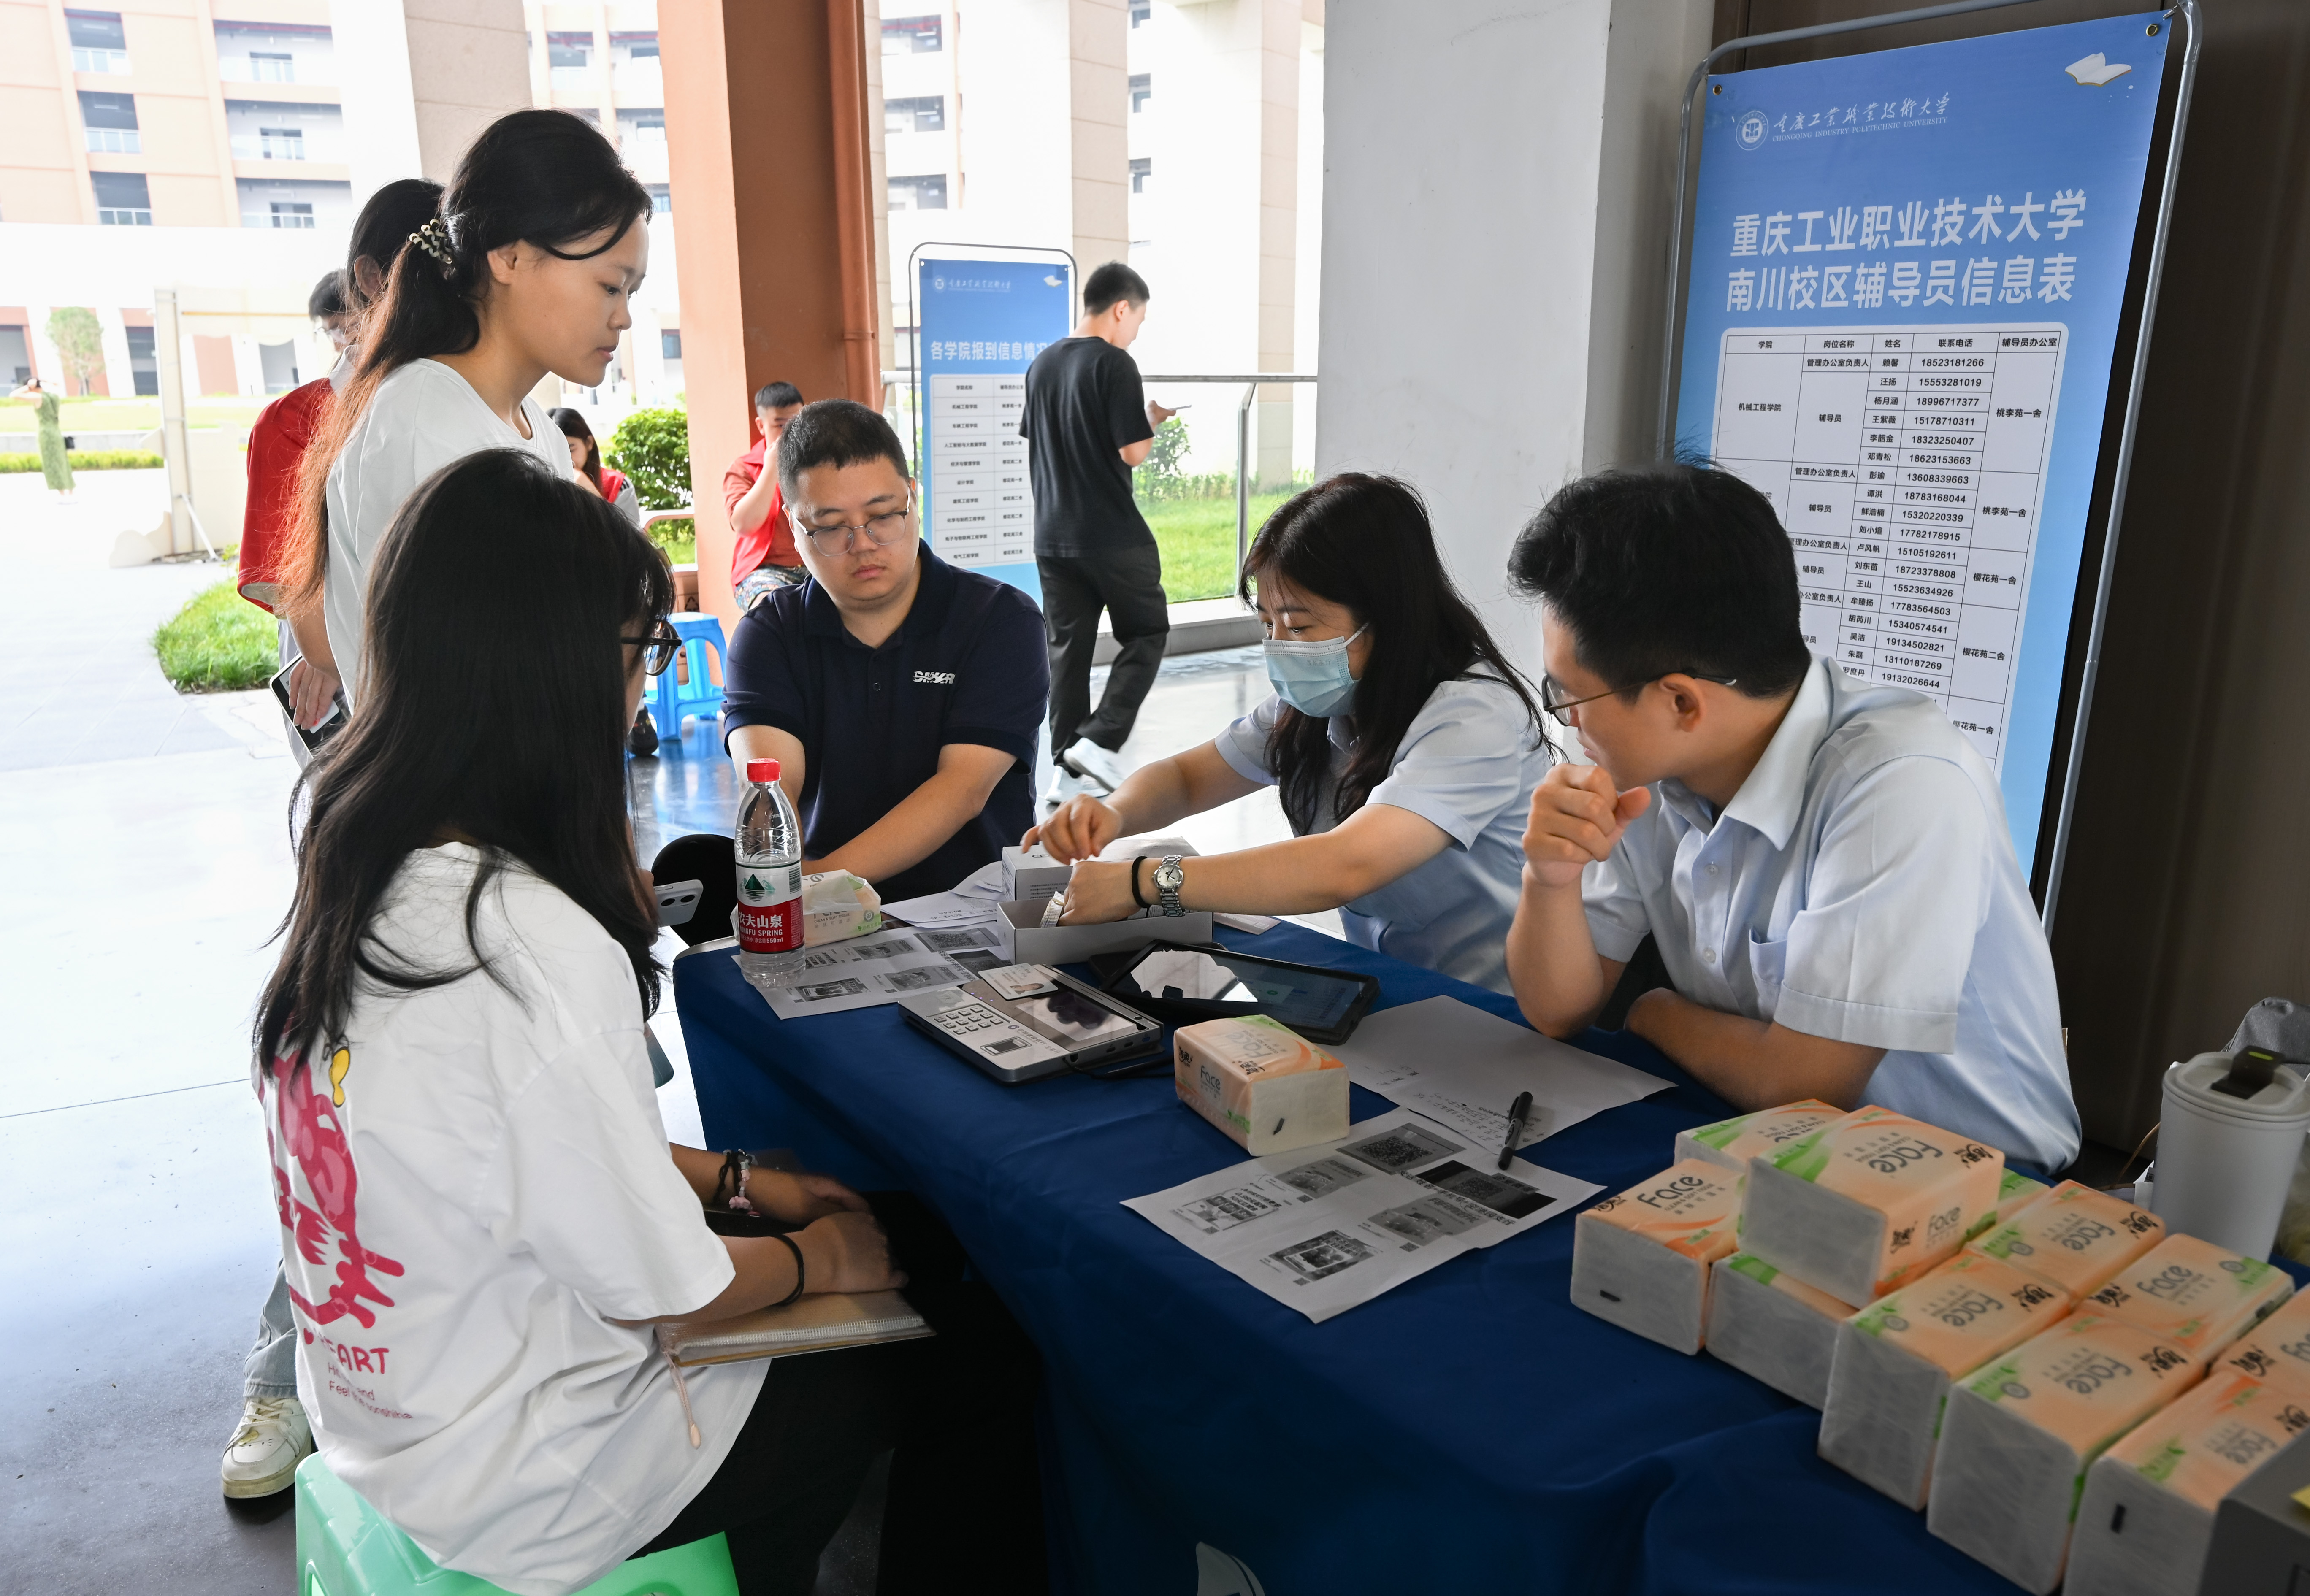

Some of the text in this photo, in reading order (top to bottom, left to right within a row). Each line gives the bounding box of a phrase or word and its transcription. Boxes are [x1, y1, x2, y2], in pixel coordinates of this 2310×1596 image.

[1773, 116, 1947, 142] CHONGQING INDUSTRY POLYTECHNIC UNIVERSITY
[1730, 188, 2086, 258] 重庆工业职业技术大学
[1726, 252, 2077, 313] 南川校区辅导员信息表
[1758, 338, 2057, 349] 学院 岗位名称 姓名 联系电话 辅导员办公室
[1807, 358, 1984, 367] 管理办公室负责人 赖馨 18523181266
[1880, 378, 1981, 387] 汪扬 15553281019
[1874, 396, 1979, 406] 杨月涵 18996717377
[1739, 403, 2041, 418] 机械工程学院 桃李苑一舍
[1819, 414, 1842, 422] 辅导员
[1872, 415, 1974, 426] 王紫薇 15178710311
[1869, 434, 1974, 445] 李韶金 18323250407
[1868, 452, 1971, 465] 邓青松 18623153663
[1795, 467, 1969, 484] 管理办公室负责人 彭瑜 13608339663
[1762, 492, 1772, 500] 院
[1867, 490, 1966, 503] 谭洪 18783168044
[1809, 504, 1831, 513] 辅导员
[1861, 507, 1963, 522] 鲜浩楠 15320220339
[1982, 506, 2027, 517] 桃李苑一舍
[1900, 529, 1961, 541] 17782178915
[1857, 544, 1880, 553] 卢风帆
[1898, 547, 1956, 560] 15105192611
[1802, 565, 1824, 574] 辅导员
[1855, 562, 1956, 579] 刘东苗 18723378808
[1973, 573, 2017, 585] 樱花苑一舍
[1856, 580, 1953, 597] 王山 15523634926
[1850, 597, 1874, 607] 牟臻扬
[1891, 602, 1951, 616] 17783564503
[1848, 614, 1947, 634] 胡芮川 15340574541
[1850, 633, 1944, 652] 吴洁 19134502821
[1848, 650, 1942, 670] 朱磊 13110187269
[1963, 647, 2005, 661] 樱花苑二舍
[1882, 673, 1940, 688] 19132026644
[739, 911, 783, 928] 农夫山泉
[1200, 1065, 1221, 1090] Face
[1868, 1140, 1943, 1174] Face
[1637, 1176, 1703, 1208] Face
[2061, 1220, 2115, 1251] Face
[2136, 1265, 2193, 1298] Face
[1942, 1292, 2004, 1327] Face
[2065, 1356, 2133, 1395] Face
